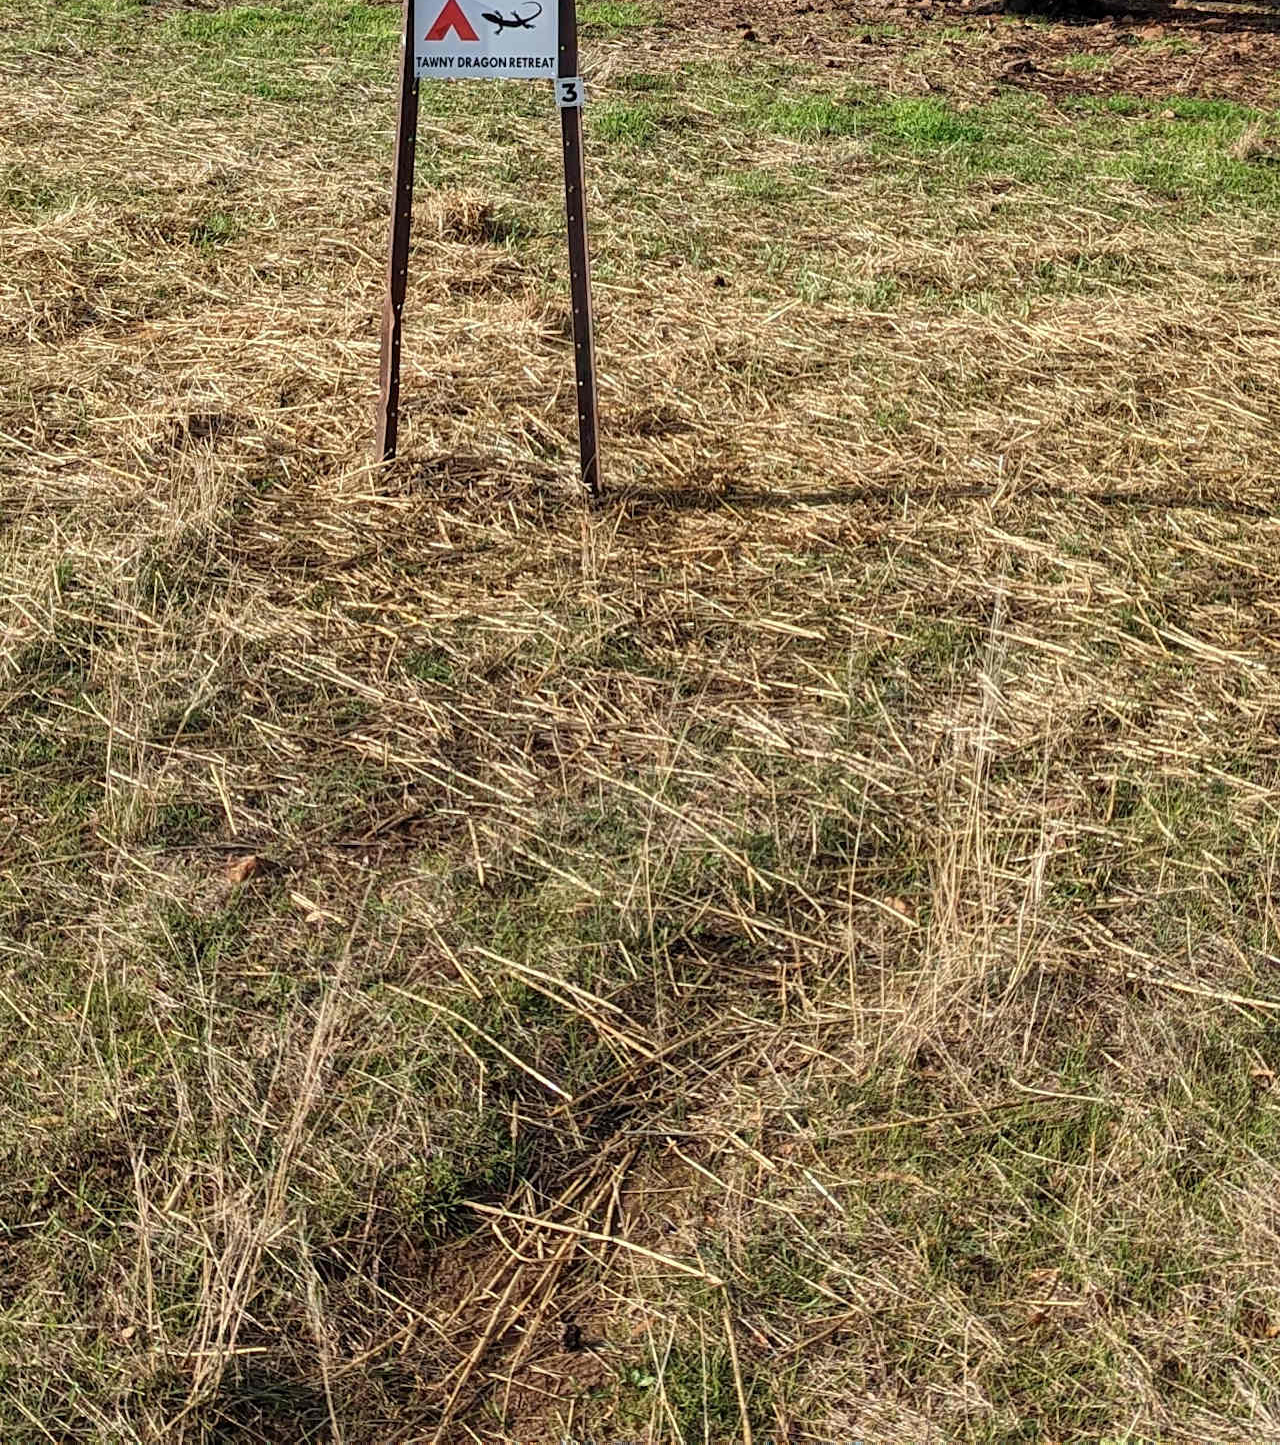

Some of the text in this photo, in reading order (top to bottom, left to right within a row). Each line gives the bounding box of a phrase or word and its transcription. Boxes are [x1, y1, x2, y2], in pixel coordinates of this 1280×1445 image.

[416, 56, 555, 68] TAWNY DRAGON RETREAT
[562, 83, 577, 102] 3
